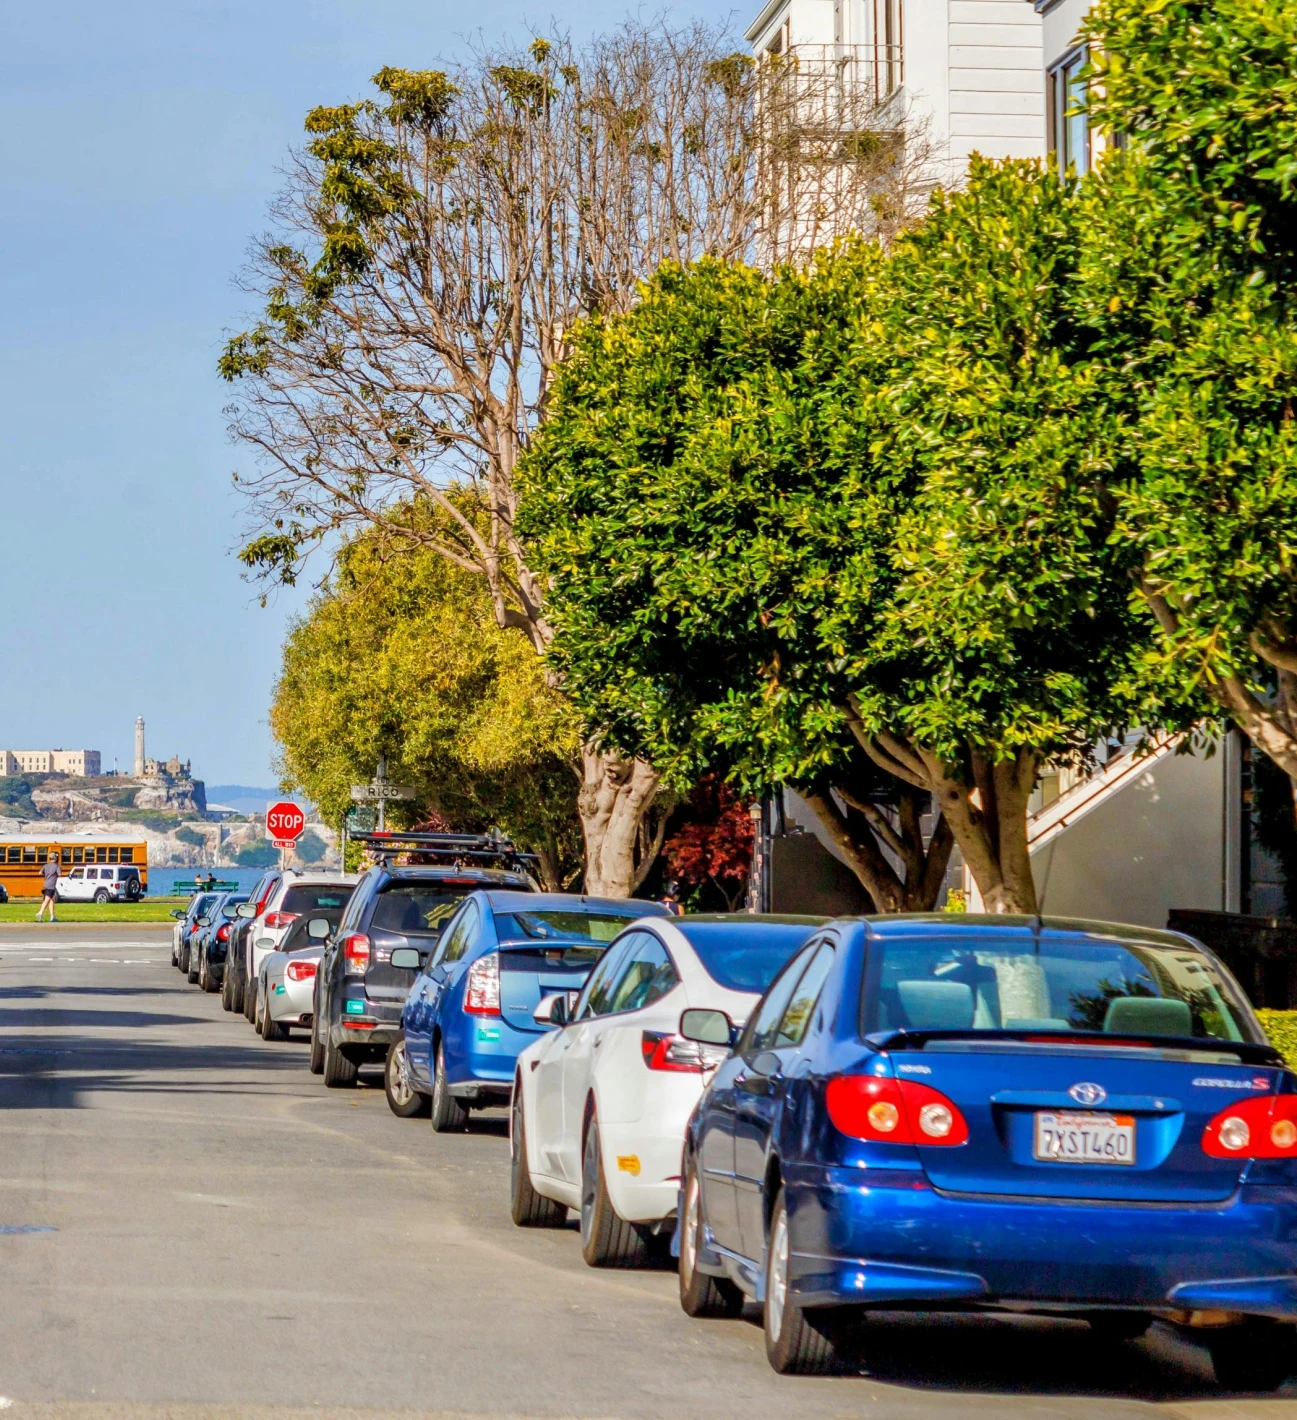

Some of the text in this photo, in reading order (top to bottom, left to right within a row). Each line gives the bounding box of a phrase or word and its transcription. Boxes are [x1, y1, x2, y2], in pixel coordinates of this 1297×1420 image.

[368, 787, 399, 797] RICO
[269, 813, 303, 829] STOP
[1252, 1078, 1271, 1090] S
[1043, 1129, 1128, 1156] 7XST460
